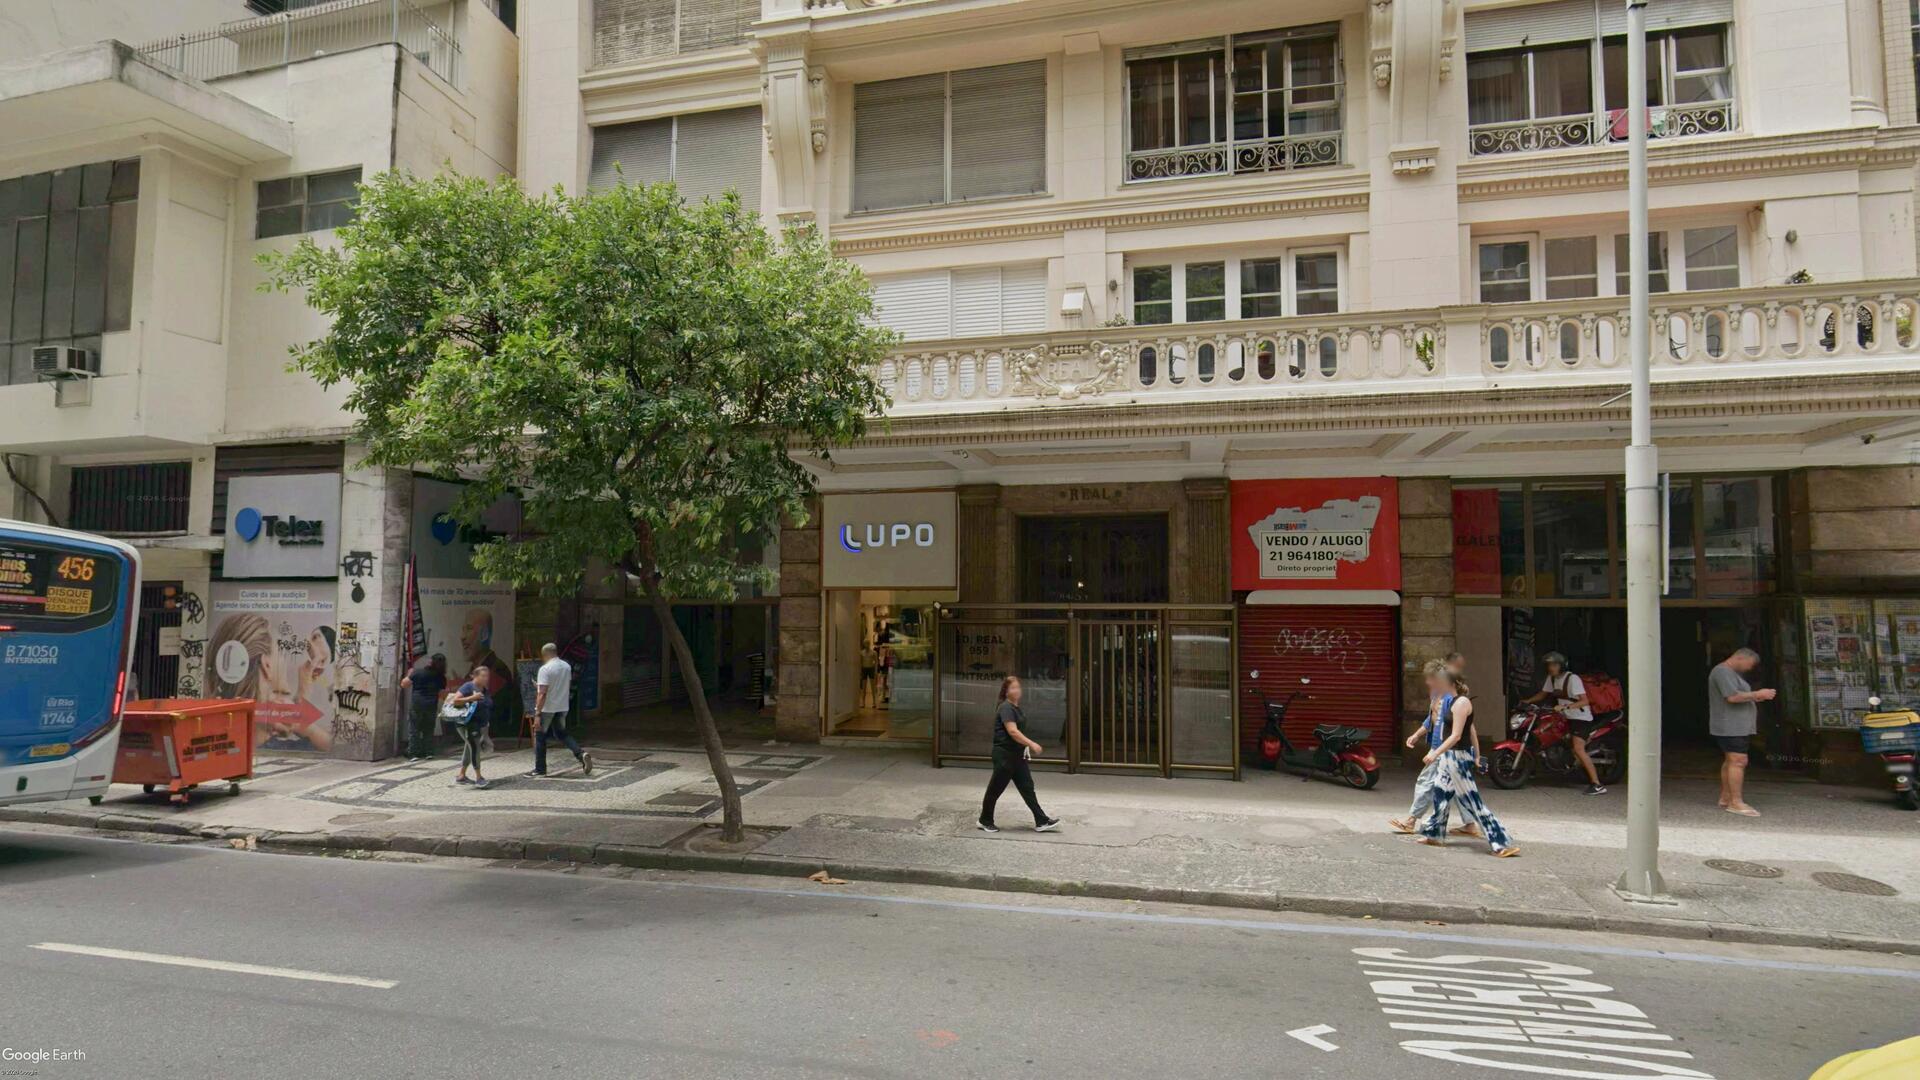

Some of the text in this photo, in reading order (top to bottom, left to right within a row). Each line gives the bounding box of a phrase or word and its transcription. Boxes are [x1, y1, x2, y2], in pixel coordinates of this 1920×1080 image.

[1070, 487, 1110, 500] REAL
[262, 515, 323, 537] Telex
[841, 523, 934, 551] LUPO
[1266, 535, 1363, 546] VENDO / ALUGO
[1270, 551, 1283, 561] 21
[57, 556, 95, 580] 456
[1277, 564, 1337, 573] Direto propriet
[47, 588, 89, 599] DISQUE
[282, 591, 306, 600] audição
[215, 602, 238, 610] Agende
[976, 635, 1005, 644] REAL
[6, 645, 59, 658] B 71050
[969, 647, 989, 656] 959
[58, 698, 74, 707] Rio
[42, 712, 75, 725] 1746
